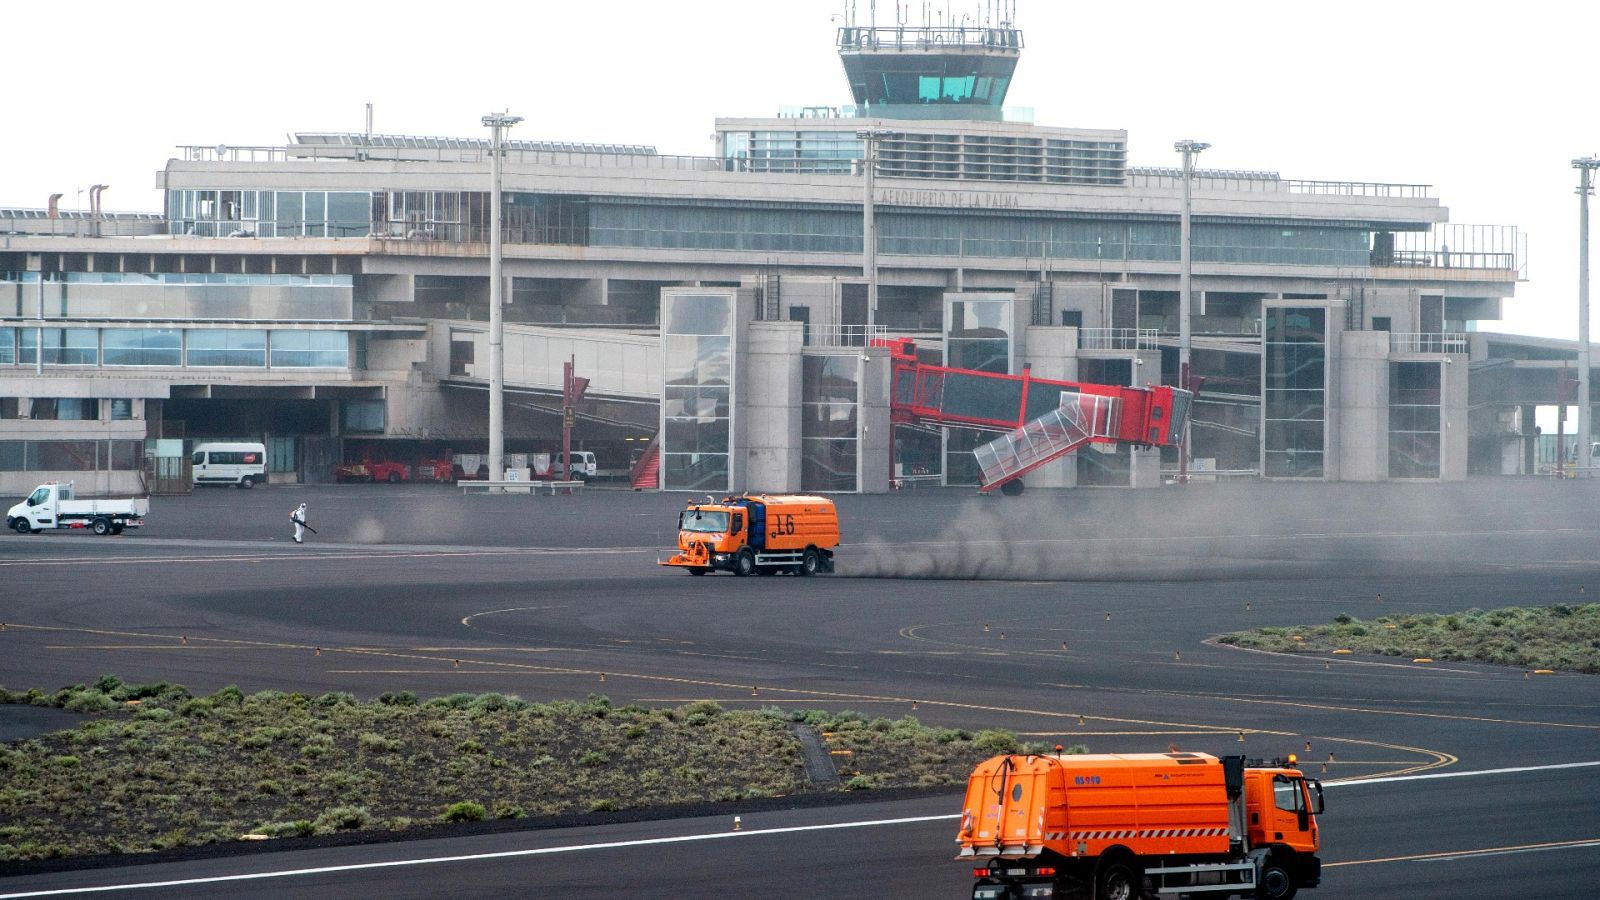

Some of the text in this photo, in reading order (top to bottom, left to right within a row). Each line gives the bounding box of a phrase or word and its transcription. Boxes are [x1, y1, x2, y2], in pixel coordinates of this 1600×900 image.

[882, 190, 1019, 208] AEROPUERTO DE LA PALMA
